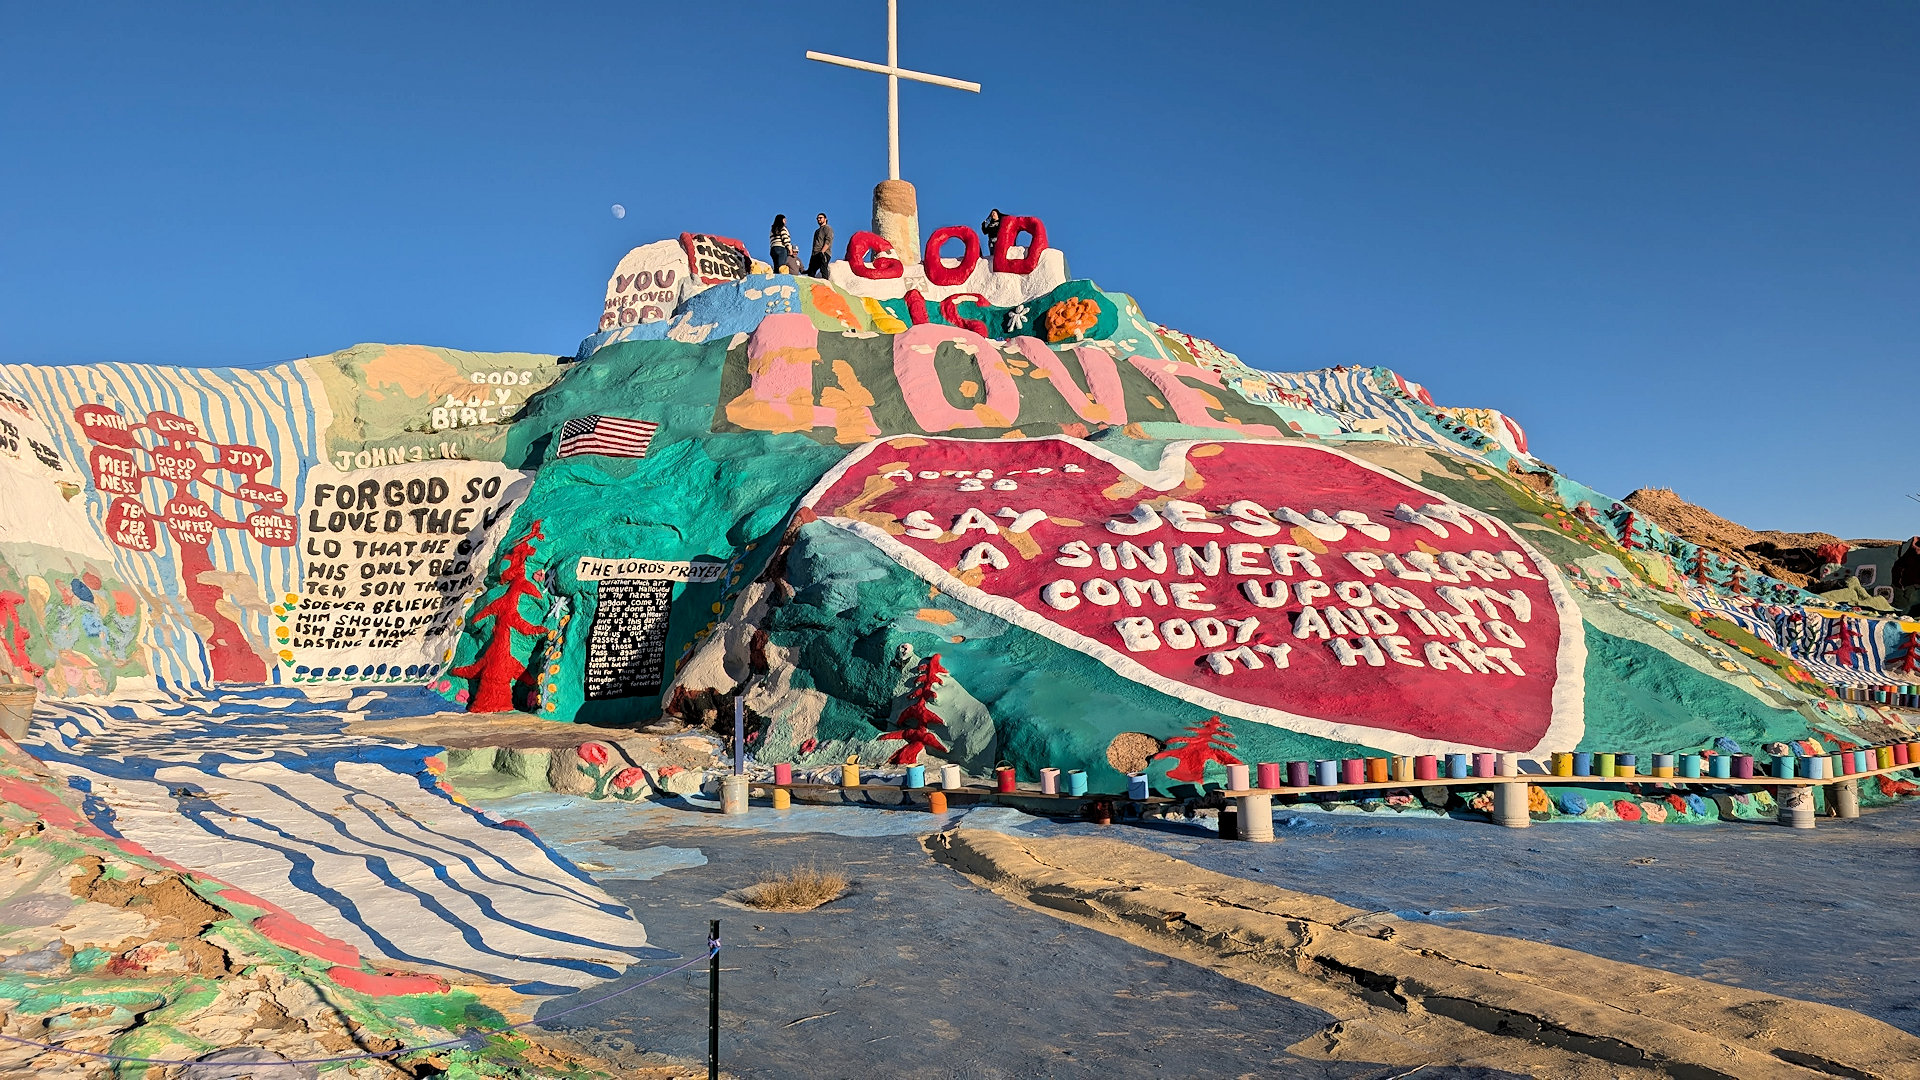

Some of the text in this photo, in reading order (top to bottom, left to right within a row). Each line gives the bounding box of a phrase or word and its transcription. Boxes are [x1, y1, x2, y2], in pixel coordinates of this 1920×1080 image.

[847, 215, 1048, 286] GOD
[616, 270, 675, 293] YOU
[600, 305, 664, 329] GOD
[905, 289, 991, 338] IS
[471, 371, 532, 385] GODS
[84, 412, 128, 431] FAITH
[156, 417, 197, 435] LOVE
[156, 453, 196, 470] GOOD
[228, 450, 263, 469] JOY
[335, 445, 405, 471] JOHN
[160, 466, 191, 480] NESS
[100, 474, 135, 493] NESS
[240, 488, 283, 502] PEACE
[315, 476, 501, 510] FOR GOD SO
[171, 504, 208, 517] LONG
[120, 519, 146, 535] PER
[169, 518, 213, 533] SUFFER
[251, 515, 293, 529] GENTLE
[309, 510, 402, 533] LOVED
[408, 508, 474, 535] THE
[903, 507, 1048, 539] SAY
[1105, 500, 1390, 541] JESUS
[117, 531, 151, 550] ANCE
[179, 532, 207, 544] ING
[255, 527, 291, 540] NESS
[353, 541, 417, 558] THAT
[421, 540, 450, 553] HE
[309, 562, 349, 580] HIS
[361, 560, 424, 579] ONLY
[581, 562, 614, 577] THE
[668, 565, 722, 578] PRAYER
[957, 541, 1543, 583] A SINNER PLEASE
[307, 582, 346, 598] TEN
[360, 582, 405, 597] SON
[299, 598, 365, 611] SOEVER
[1043, 577, 1531, 623] COME UPON MY
[298, 613, 330, 622] HIM
[336, 615, 404, 628] SHOULD
[410, 612, 443, 627] NOT
[1114, 606, 1526, 652] BODY AND INTO
[296, 623, 325, 636] ISH
[333, 626, 370, 638] BUT
[376, 627, 421, 639] HAVE
[294, 638, 402, 649] LASTING LIFE
[1206, 635, 1526, 677] MY HEART
